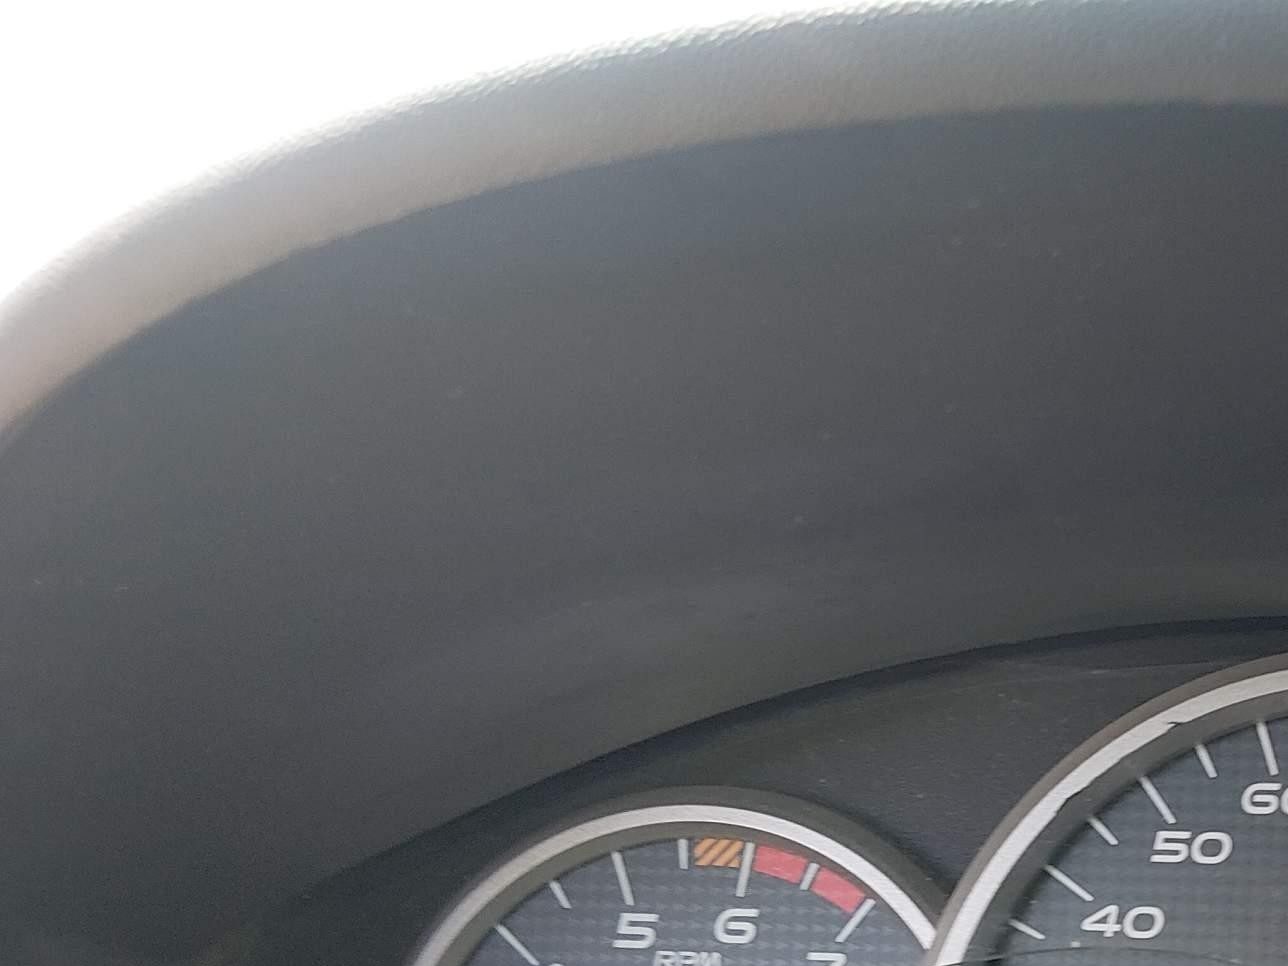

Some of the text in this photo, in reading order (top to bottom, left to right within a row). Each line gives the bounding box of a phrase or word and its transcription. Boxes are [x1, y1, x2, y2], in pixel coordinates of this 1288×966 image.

[1149, 830, 1233, 865] 50
[612, 912, 660, 950] 5
[713, 907, 760, 945] 6
[1080, 905, 1166, 939] 40
